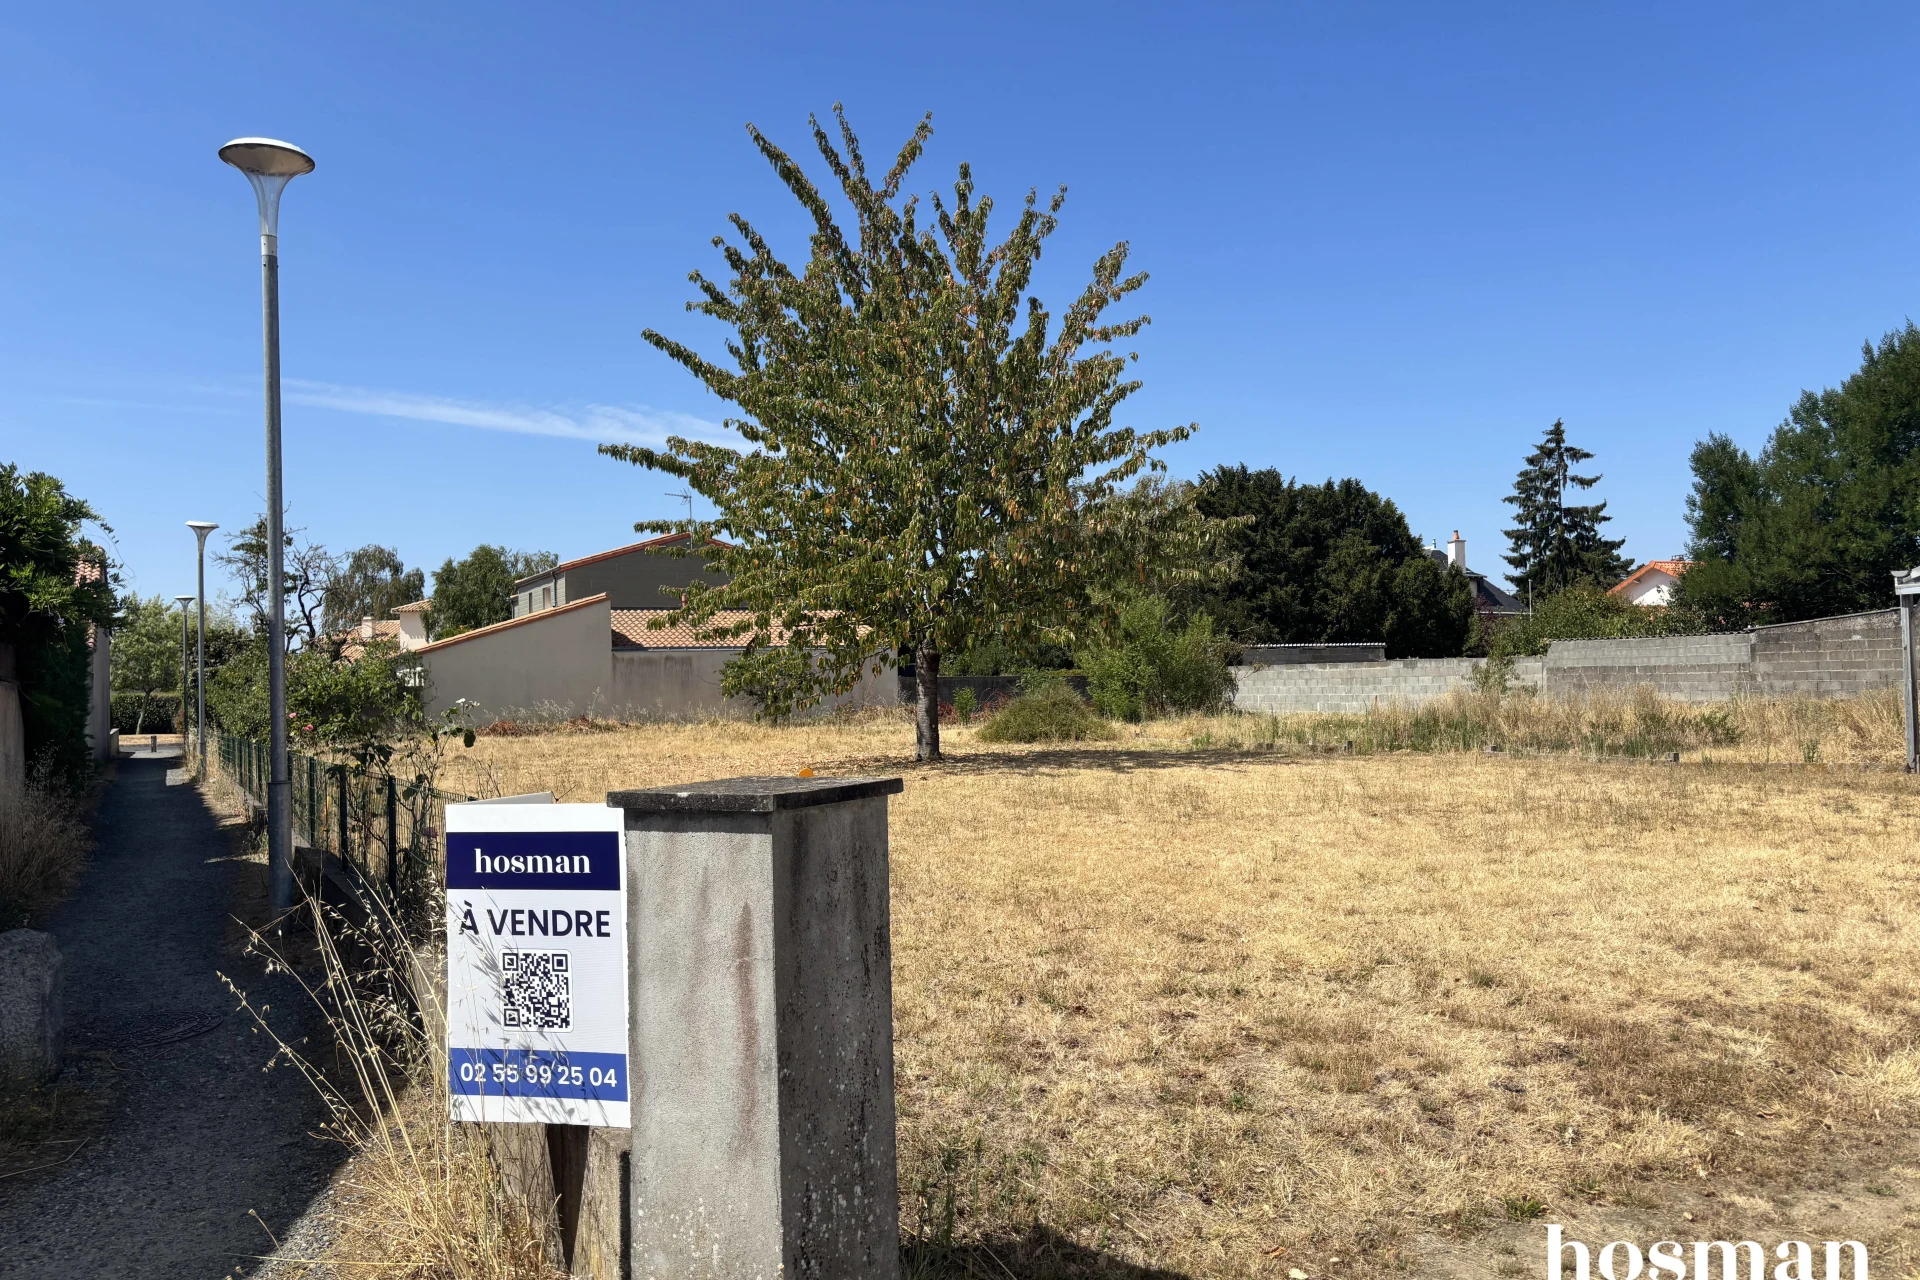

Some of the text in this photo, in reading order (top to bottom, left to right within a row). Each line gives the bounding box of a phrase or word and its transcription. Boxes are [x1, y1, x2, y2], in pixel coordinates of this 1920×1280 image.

[474, 848, 591, 874] hosman
[459, 900, 611, 938] À VENDRE
[460, 1062, 617, 1088] 02 55 99 25 04
